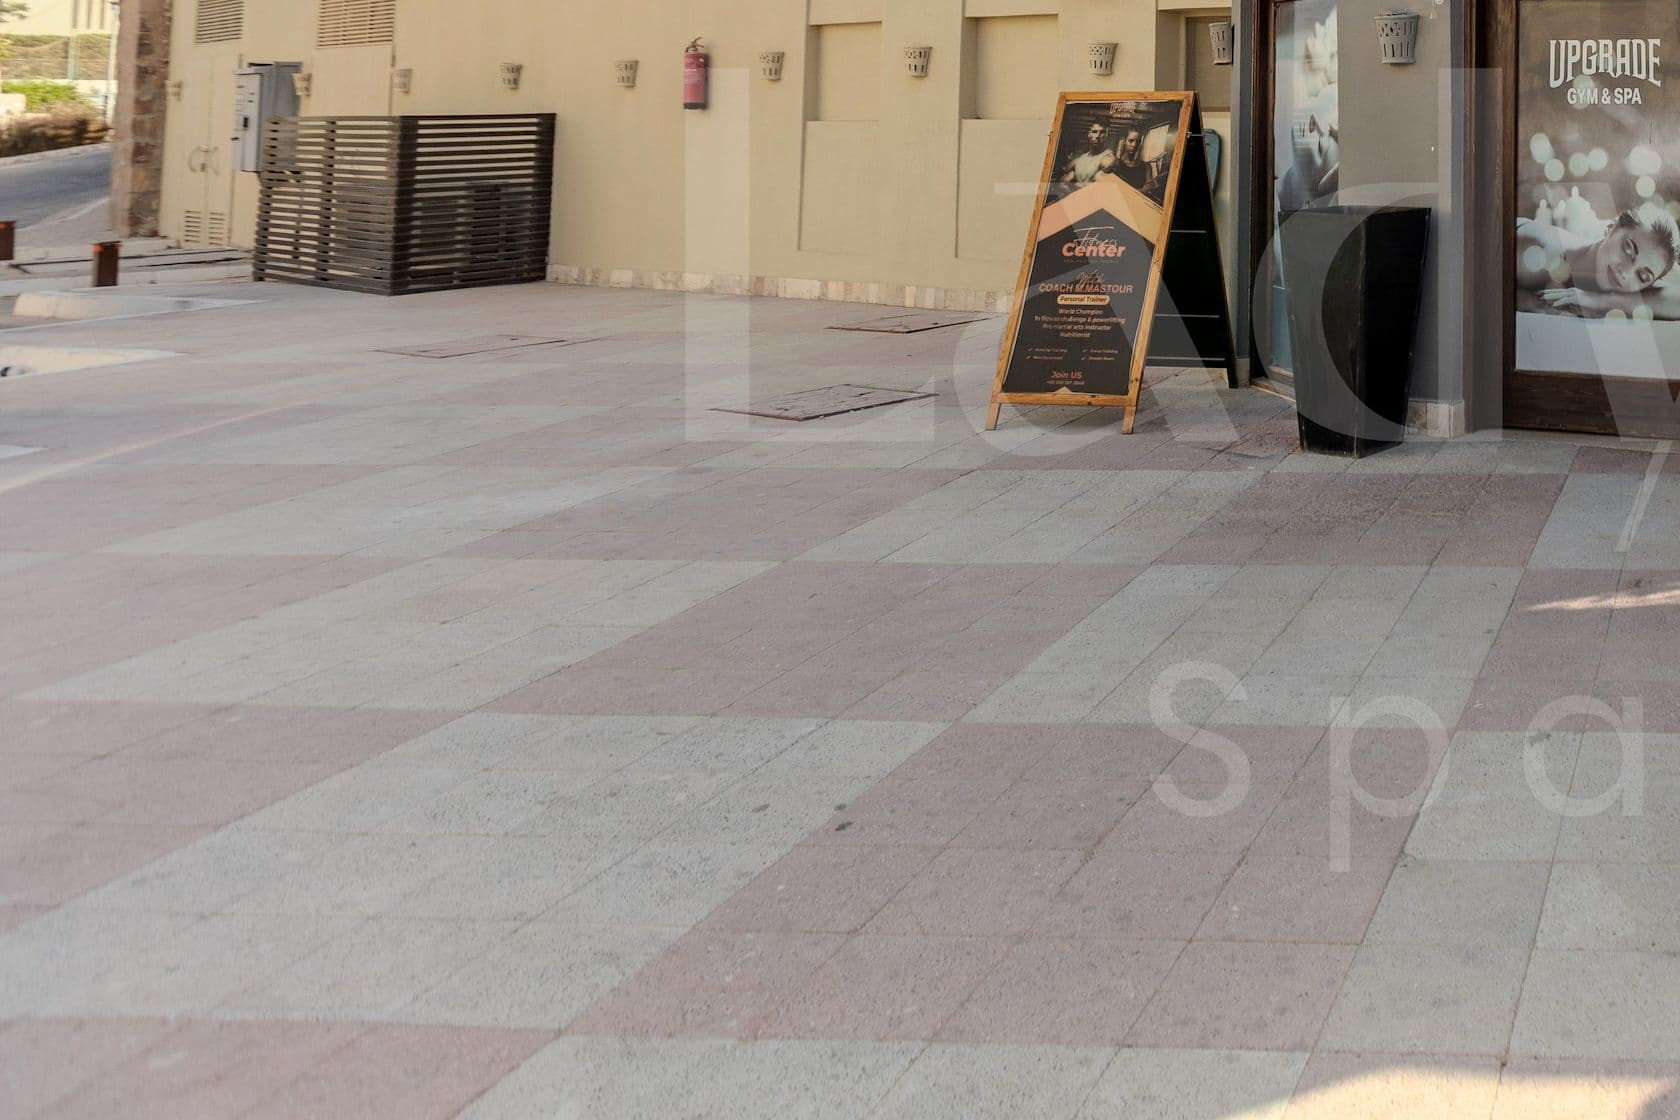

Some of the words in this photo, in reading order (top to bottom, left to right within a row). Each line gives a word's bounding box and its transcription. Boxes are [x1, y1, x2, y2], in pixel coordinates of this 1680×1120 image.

[1549, 38, 1662, 89] UPGRADE
[1567, 87, 1599, 105] GYM
[1600, 87, 1612, 105] &
[1613, 87, 1642, 105] SPA
[1062, 241, 1127, 257] Center
[1039, 283, 1073, 293] COACH
[1075, 308, 1104, 316] Champion
[1050, 371, 1069, 379] Join
[1070, 371, 1083, 379] US
